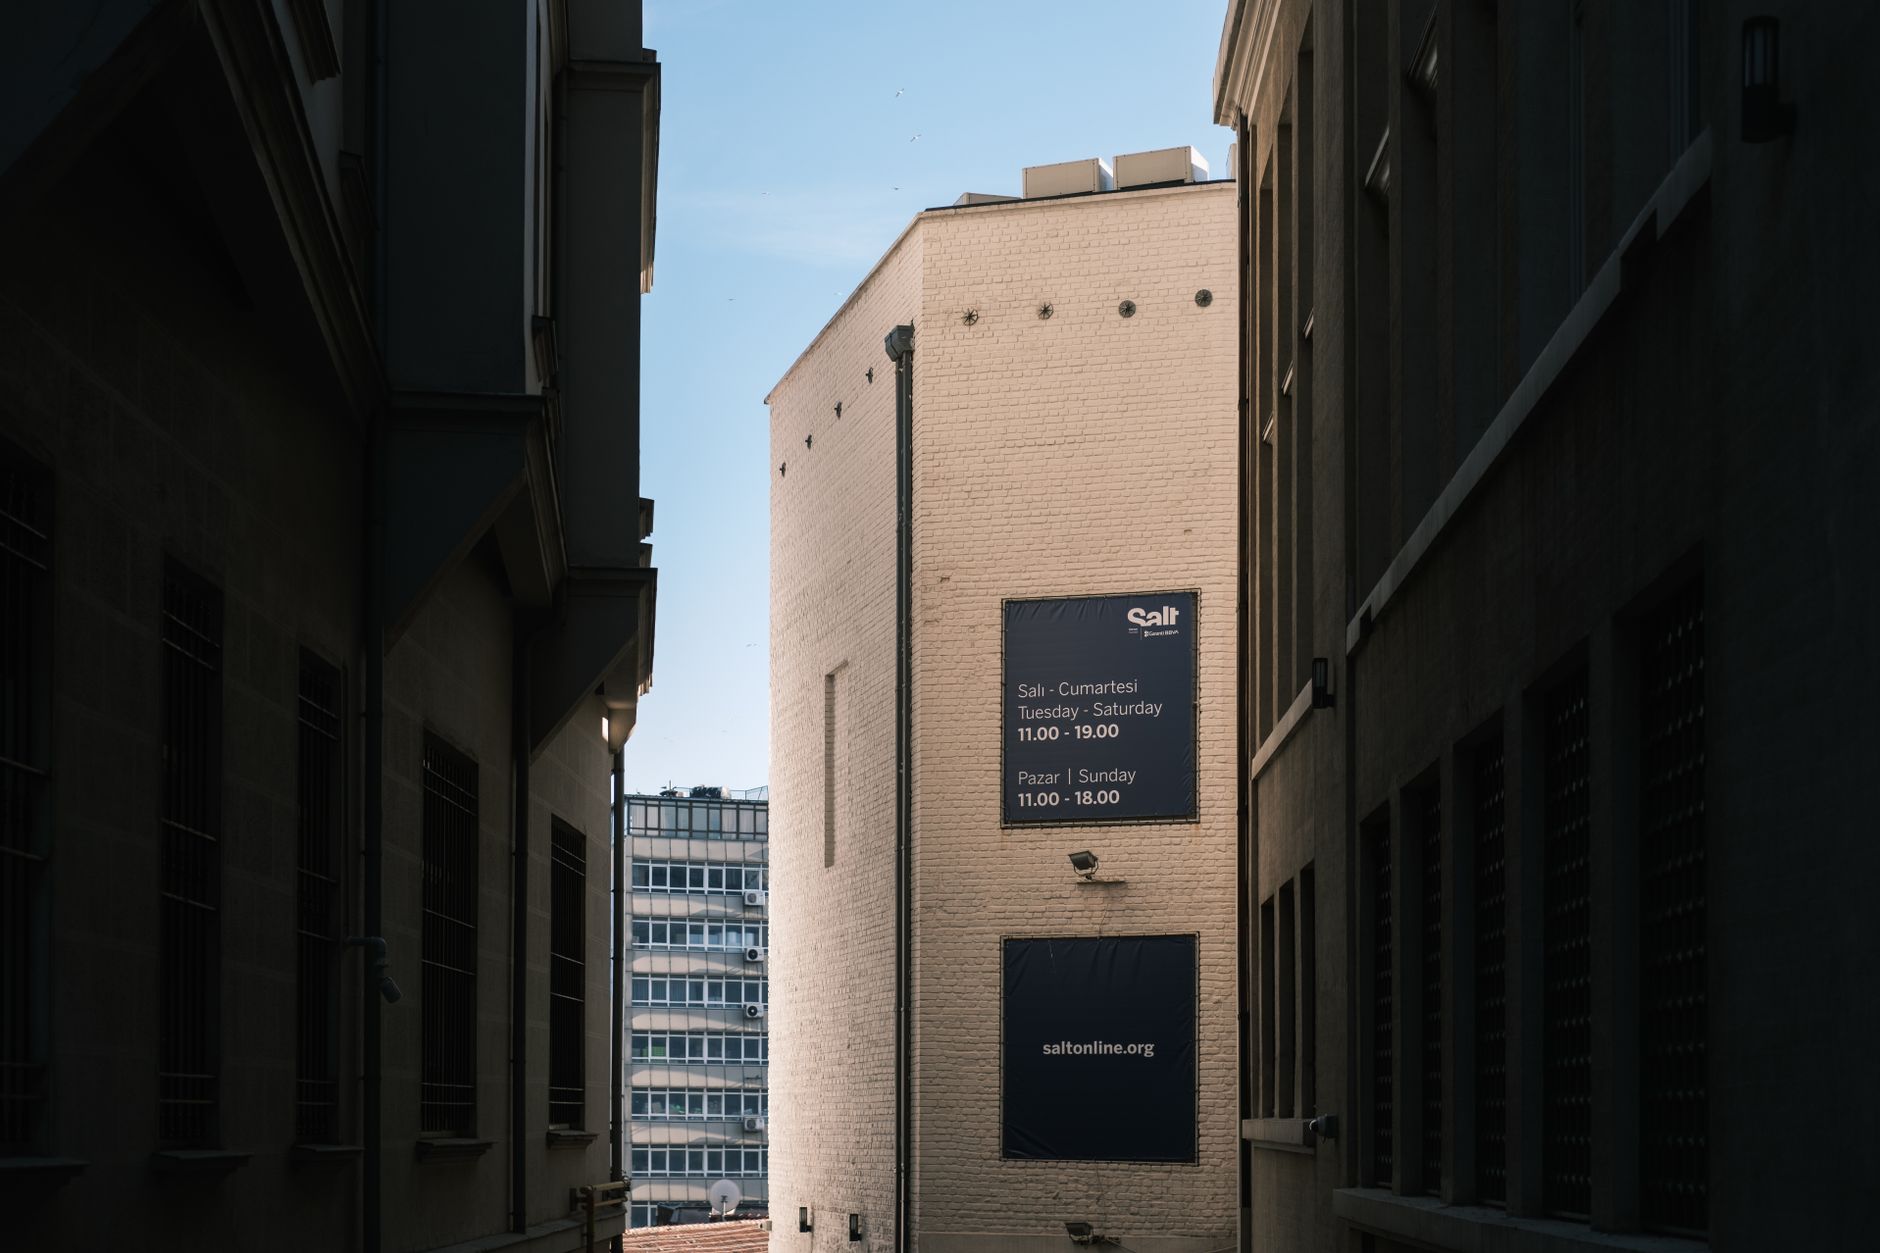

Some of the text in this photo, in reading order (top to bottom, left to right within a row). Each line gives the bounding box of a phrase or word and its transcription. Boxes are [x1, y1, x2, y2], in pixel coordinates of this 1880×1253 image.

[1127, 605, 1180, 627] Salt
[1059, 679, 1138, 696] Cumartesi
[1017, 704, 1079, 721] Tuesday
[1093, 700, 1163, 718] Saturday
[1017, 726, 1060, 741] 11.00
[1074, 723, 1120, 739] 19.00
[1018, 771, 1060, 785] Pazar
[1079, 767, 1137, 785] Sunday
[1017, 791, 1060, 807] 11.00
[1074, 789, 1120, 805] 18.00
[1043, 1040, 1155, 1058] saltonline.org
